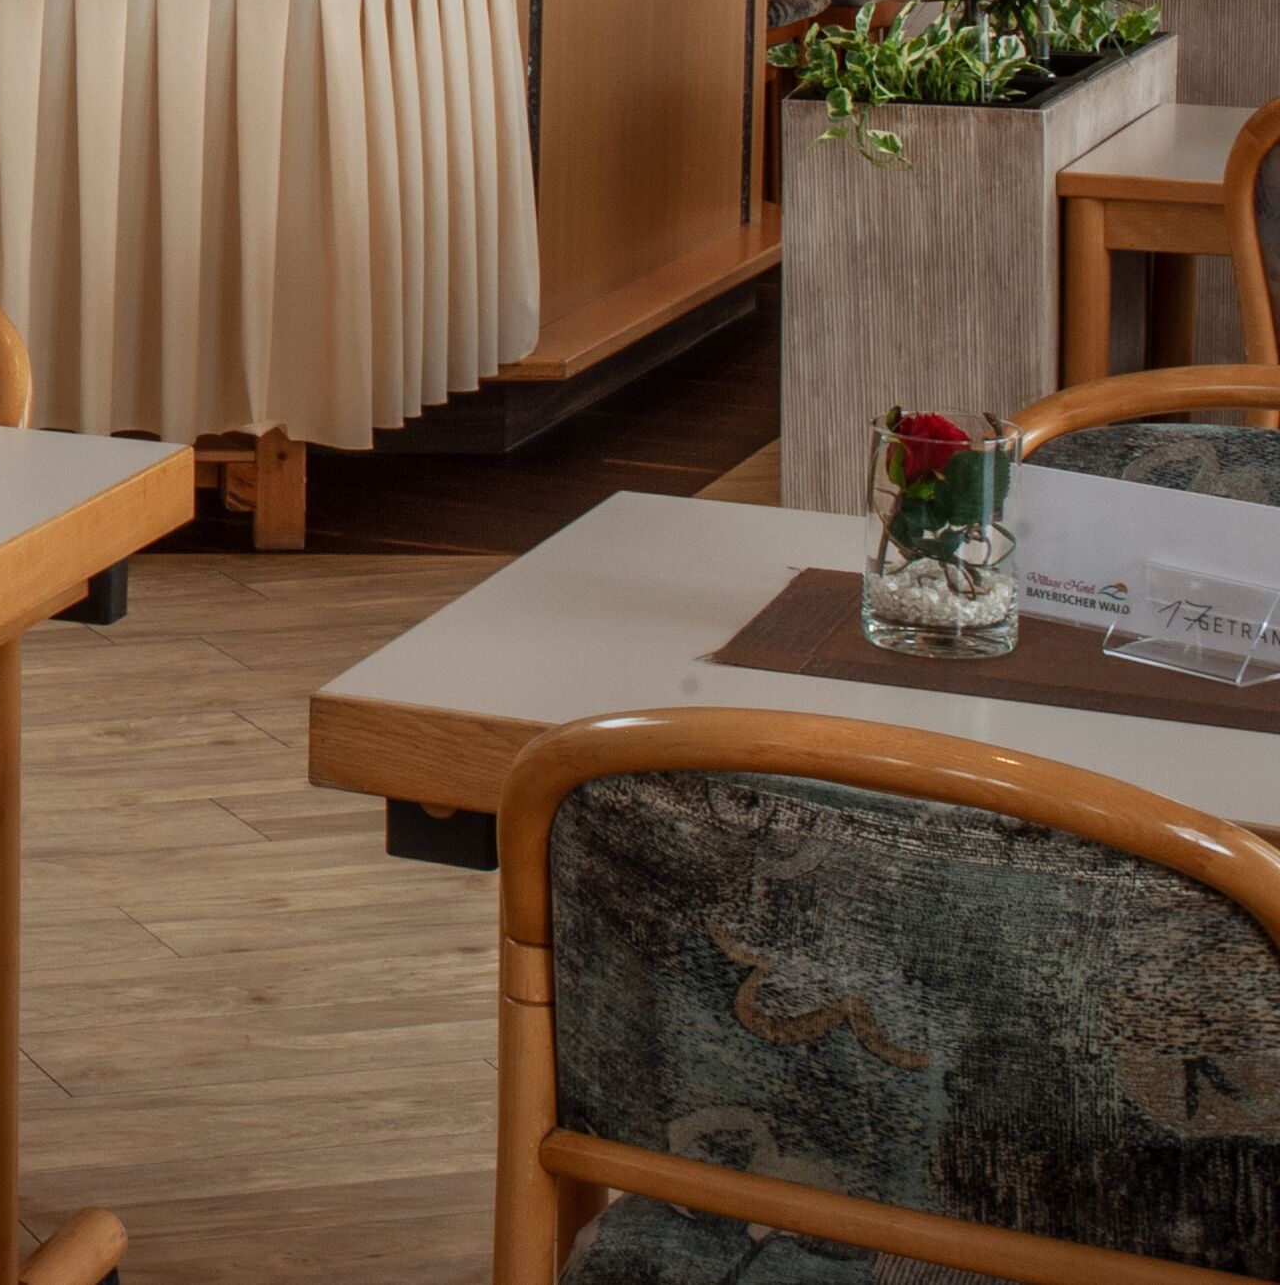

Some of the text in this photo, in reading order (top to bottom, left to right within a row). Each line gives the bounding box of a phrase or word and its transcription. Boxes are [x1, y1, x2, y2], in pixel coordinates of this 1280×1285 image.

[1026, 586, 1130, 615] BAYERISCHER WALD
[1064, 578, 1096, 595] Hotel
[1158, 600, 1213, 631] 17
